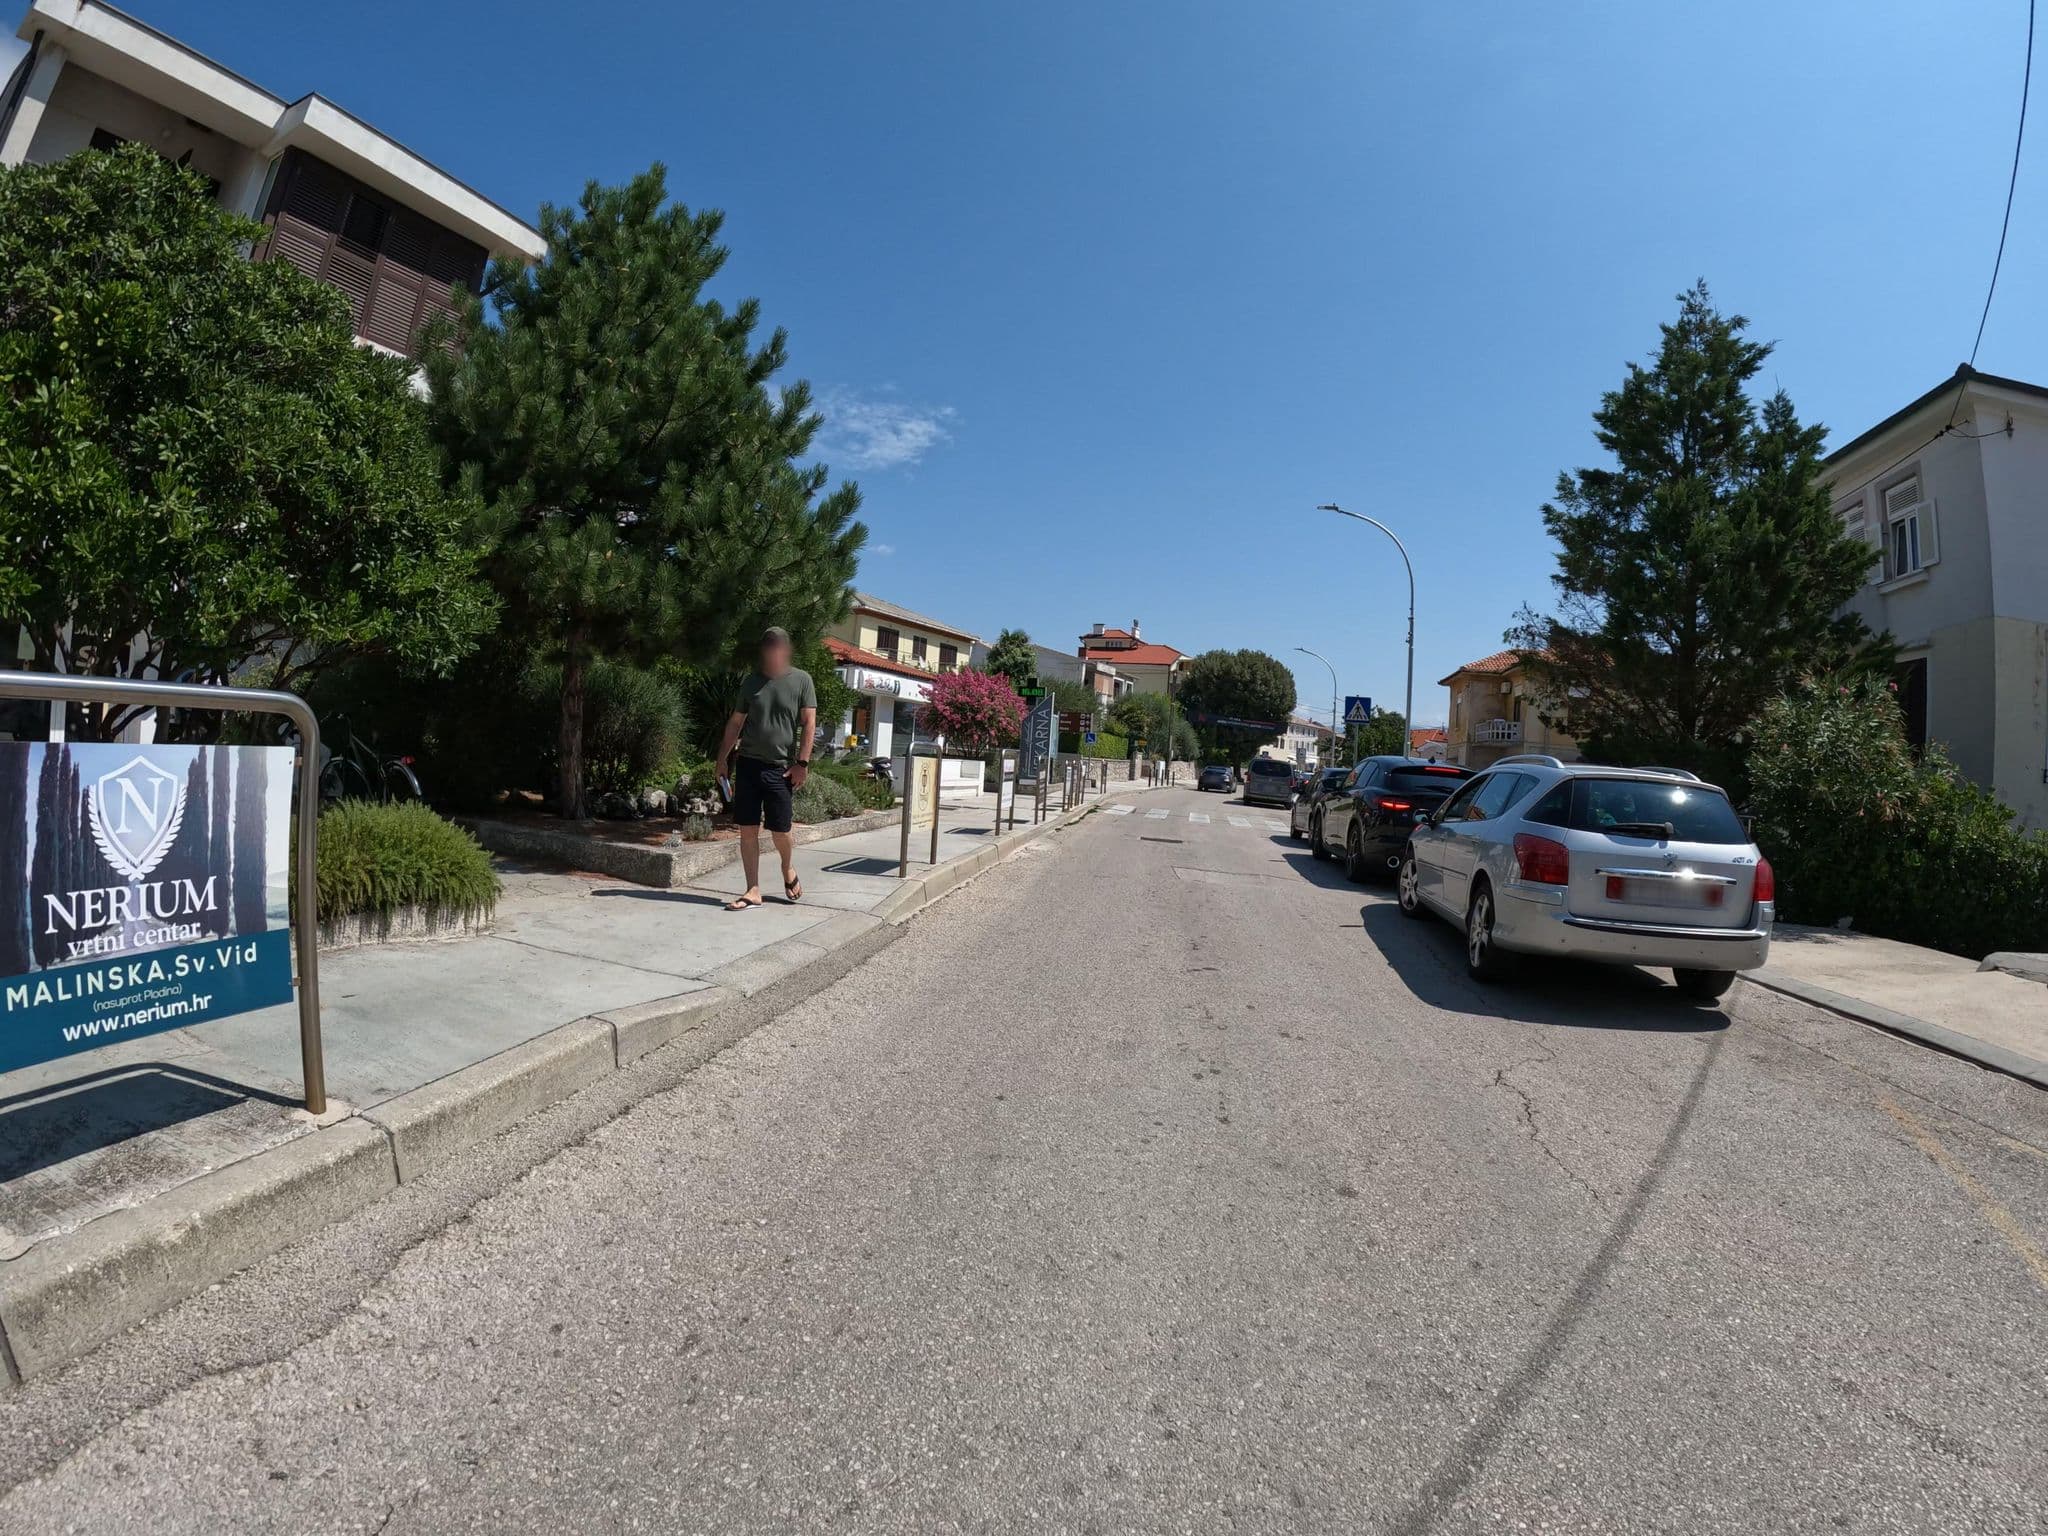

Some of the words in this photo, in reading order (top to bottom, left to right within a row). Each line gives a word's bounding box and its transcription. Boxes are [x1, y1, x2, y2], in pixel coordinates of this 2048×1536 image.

[116, 777, 164, 834] N
[43, 875, 218, 935] NERIUM
[67, 927, 125, 957] vrtni
[133, 921, 201, 947] centar
[62, 993, 212, 1042] www.nerium.hr
[93, 993, 142, 1013] (nasuprot
